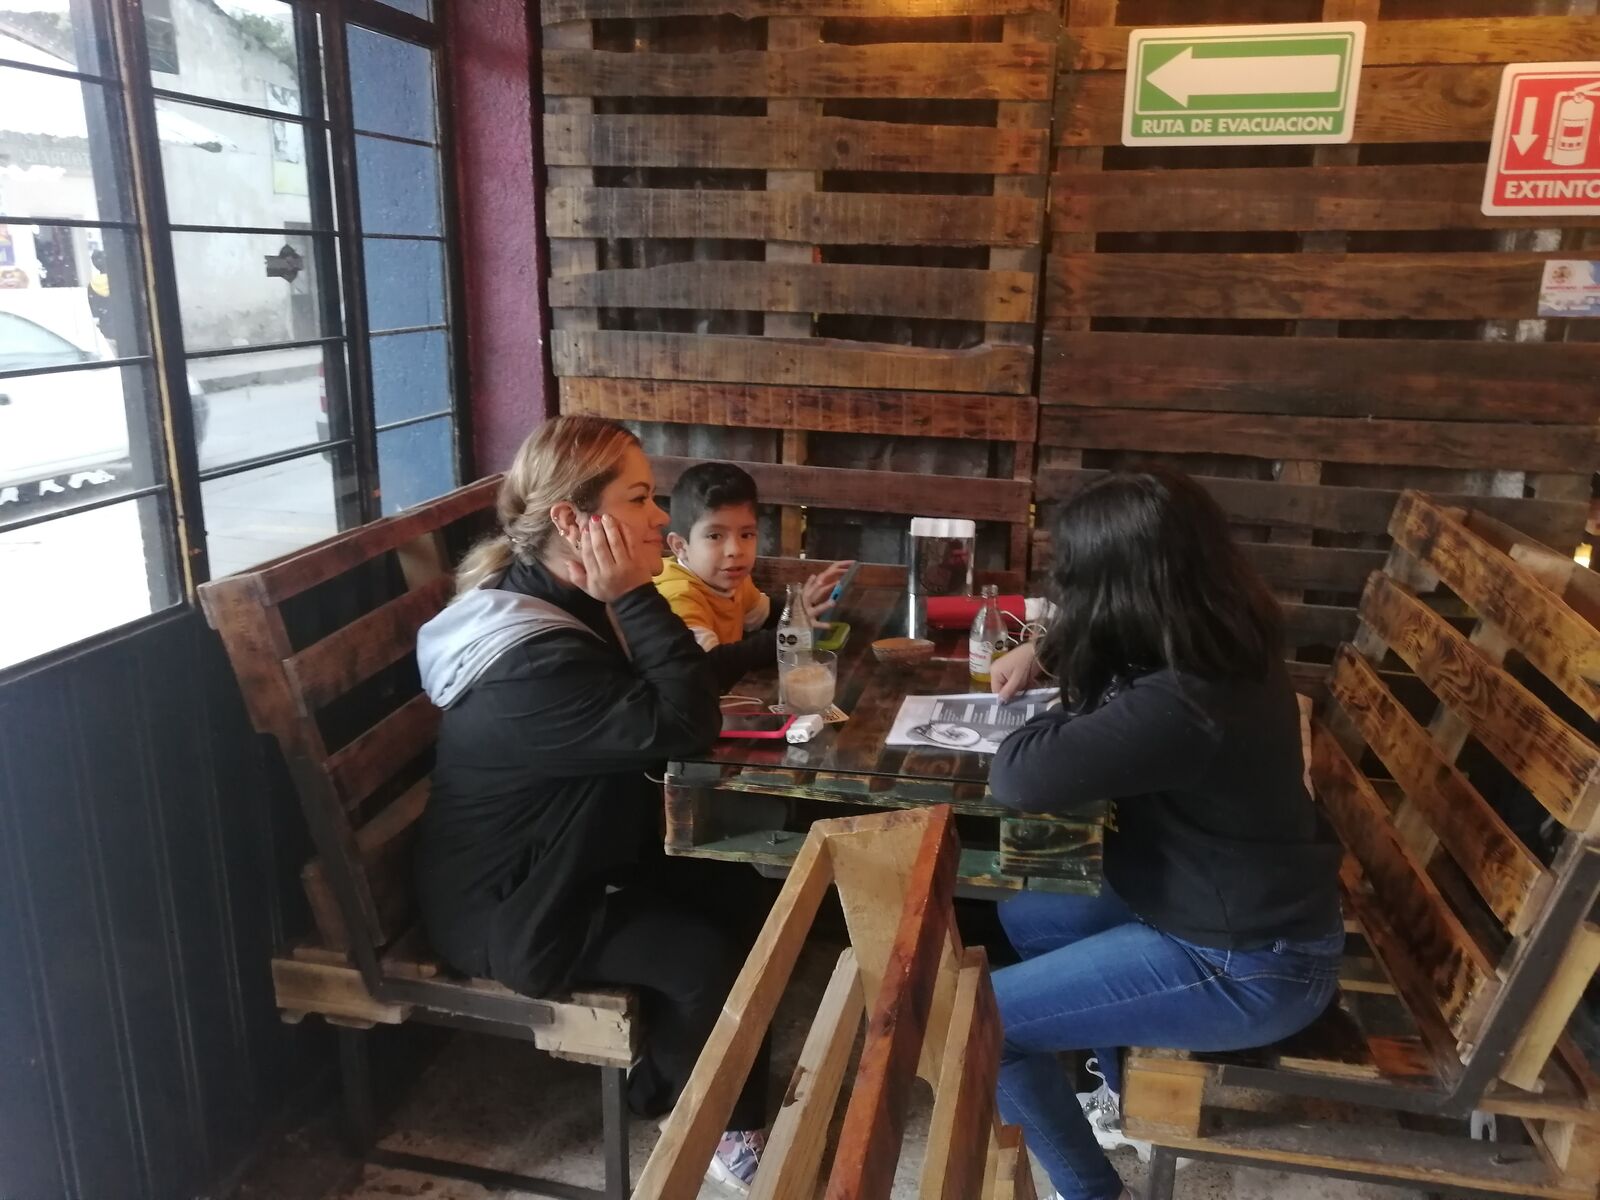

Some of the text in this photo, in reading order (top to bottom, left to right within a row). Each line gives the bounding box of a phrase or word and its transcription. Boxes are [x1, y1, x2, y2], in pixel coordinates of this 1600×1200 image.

[1141, 116, 1334, 134] RUTA DE EVACUACION
[1504, 179, 1600, 199] EXTINTO
